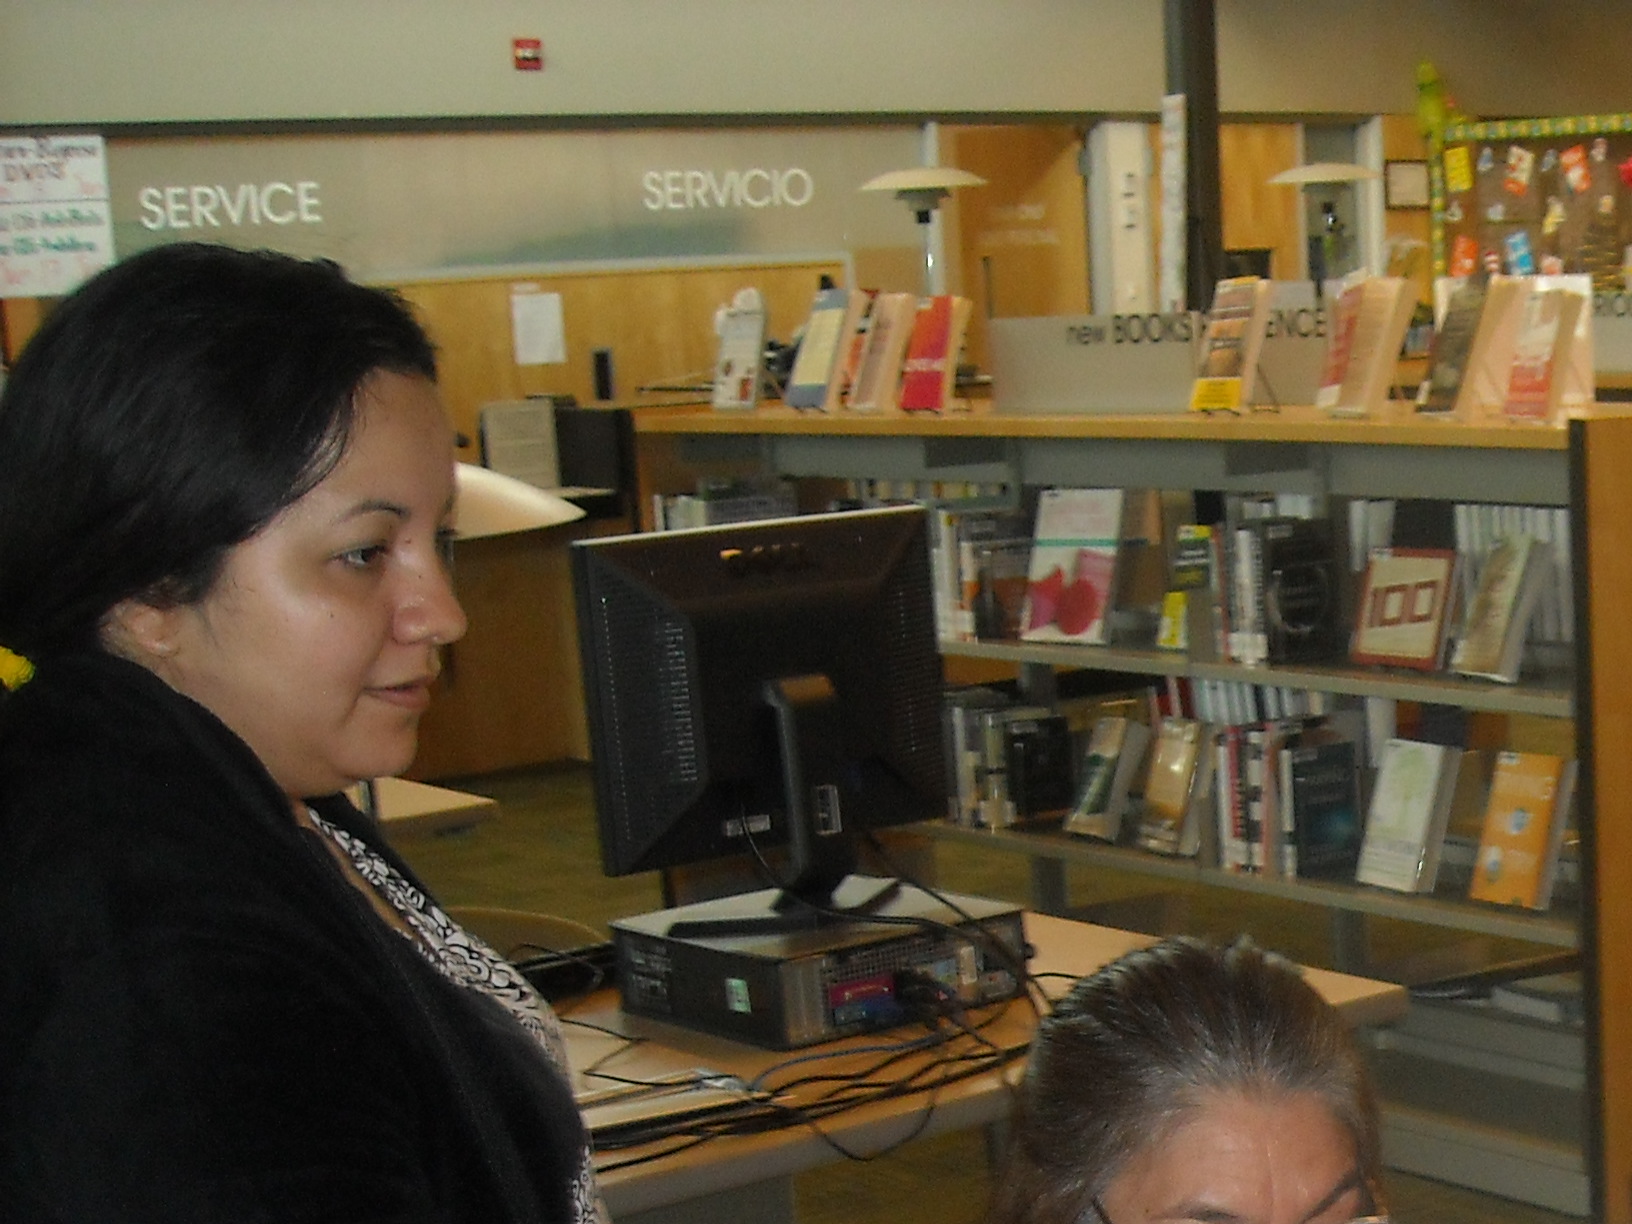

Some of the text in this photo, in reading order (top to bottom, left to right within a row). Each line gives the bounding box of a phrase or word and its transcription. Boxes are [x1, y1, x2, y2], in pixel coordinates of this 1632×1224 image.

[139, 180, 323, 231] SERVICE
[643, 168, 813, 212] SERVICIO
[1066, 325, 1105, 344] new
[1112, 313, 1192, 343] BOOKS
